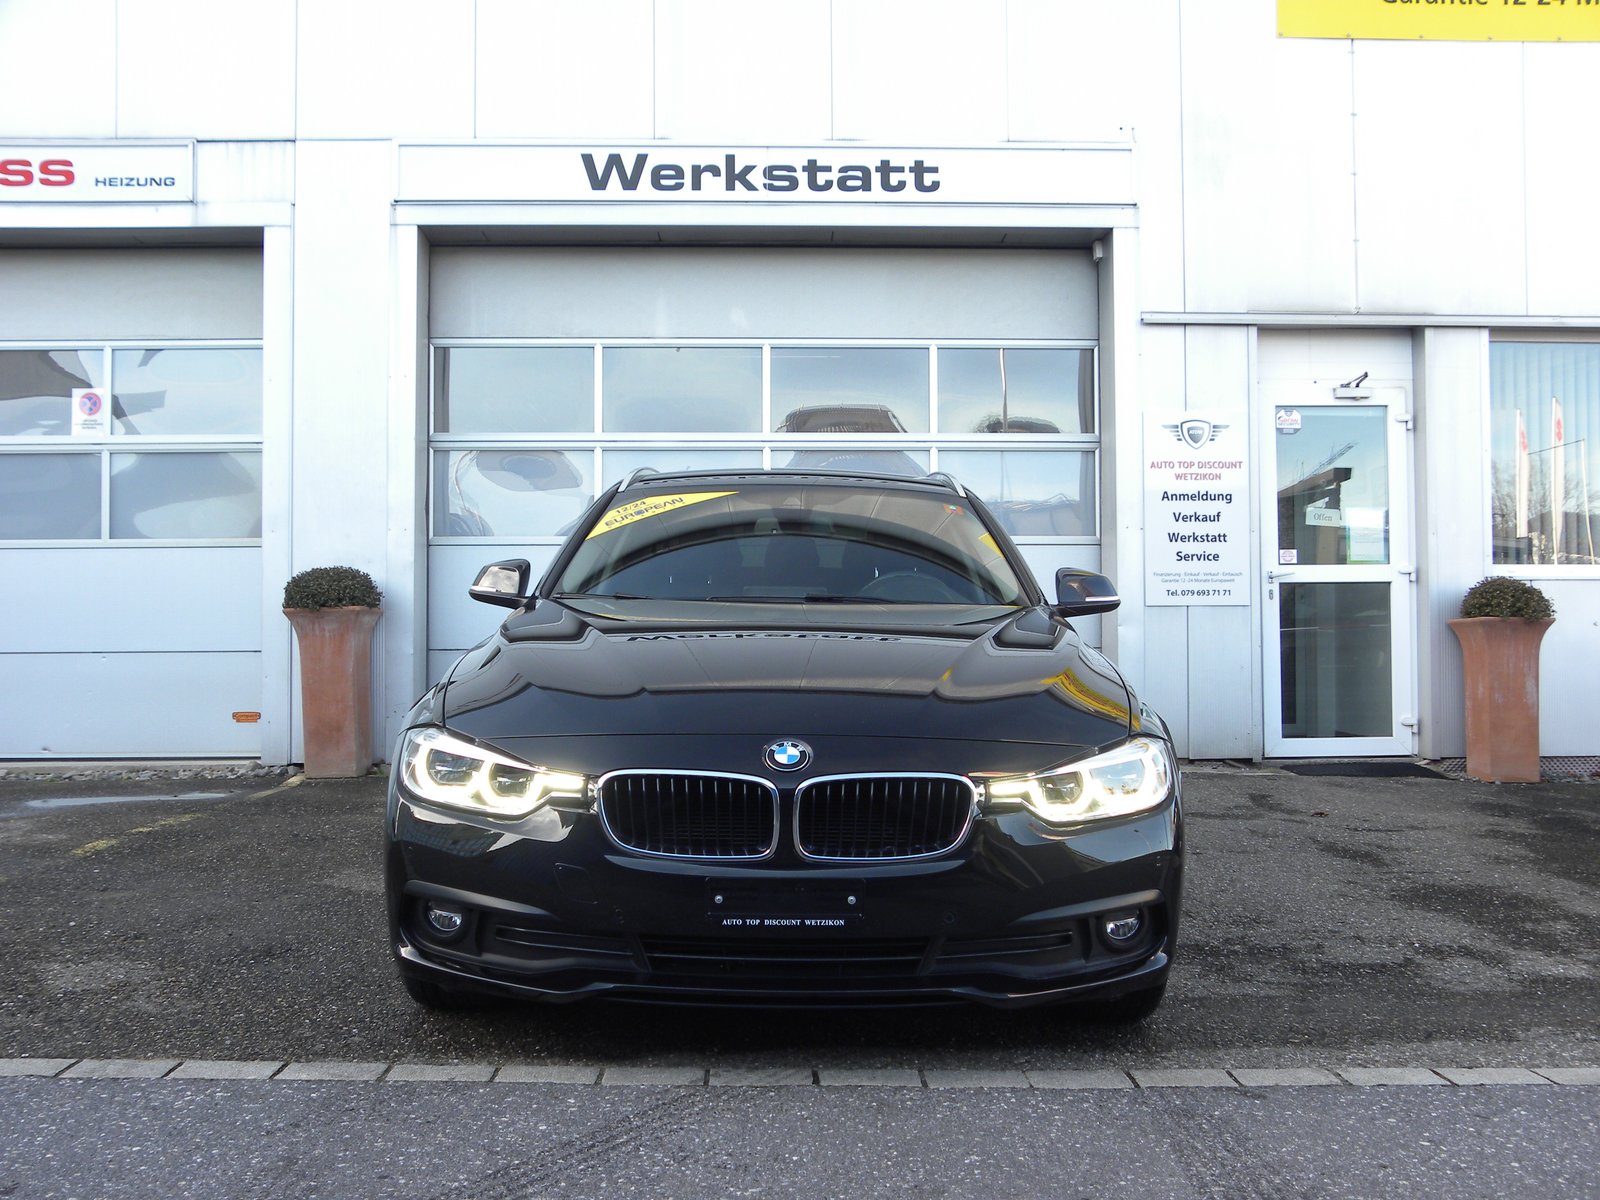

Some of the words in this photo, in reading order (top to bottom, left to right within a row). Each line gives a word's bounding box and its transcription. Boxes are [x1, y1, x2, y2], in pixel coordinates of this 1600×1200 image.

[580, 153, 941, 192] Werkstatt
[95, 177, 176, 187] HEIZUNG
[1150, 461, 1175, 469] AUTO
[1177, 461, 1195, 469] TOP
[1197, 461, 1243, 469] DISCOUNT
[1161, 491, 1232, 504] Anmeldung
[604, 497, 684, 527] EUROPEAN
[1173, 511, 1221, 522] Verkauf
[1313, 513, 1333, 522] Offen
[1168, 532, 1227, 543] Werkstatt
[1176, 551, 1220, 561] Service
[1166, 589, 1180, 597] Tel.
[1181, 589, 1195, 597] 079
[1196, 589, 1210, 597] 693
[1212, 589, 1221, 597] 71
[1222, 589, 1231, 597] 71
